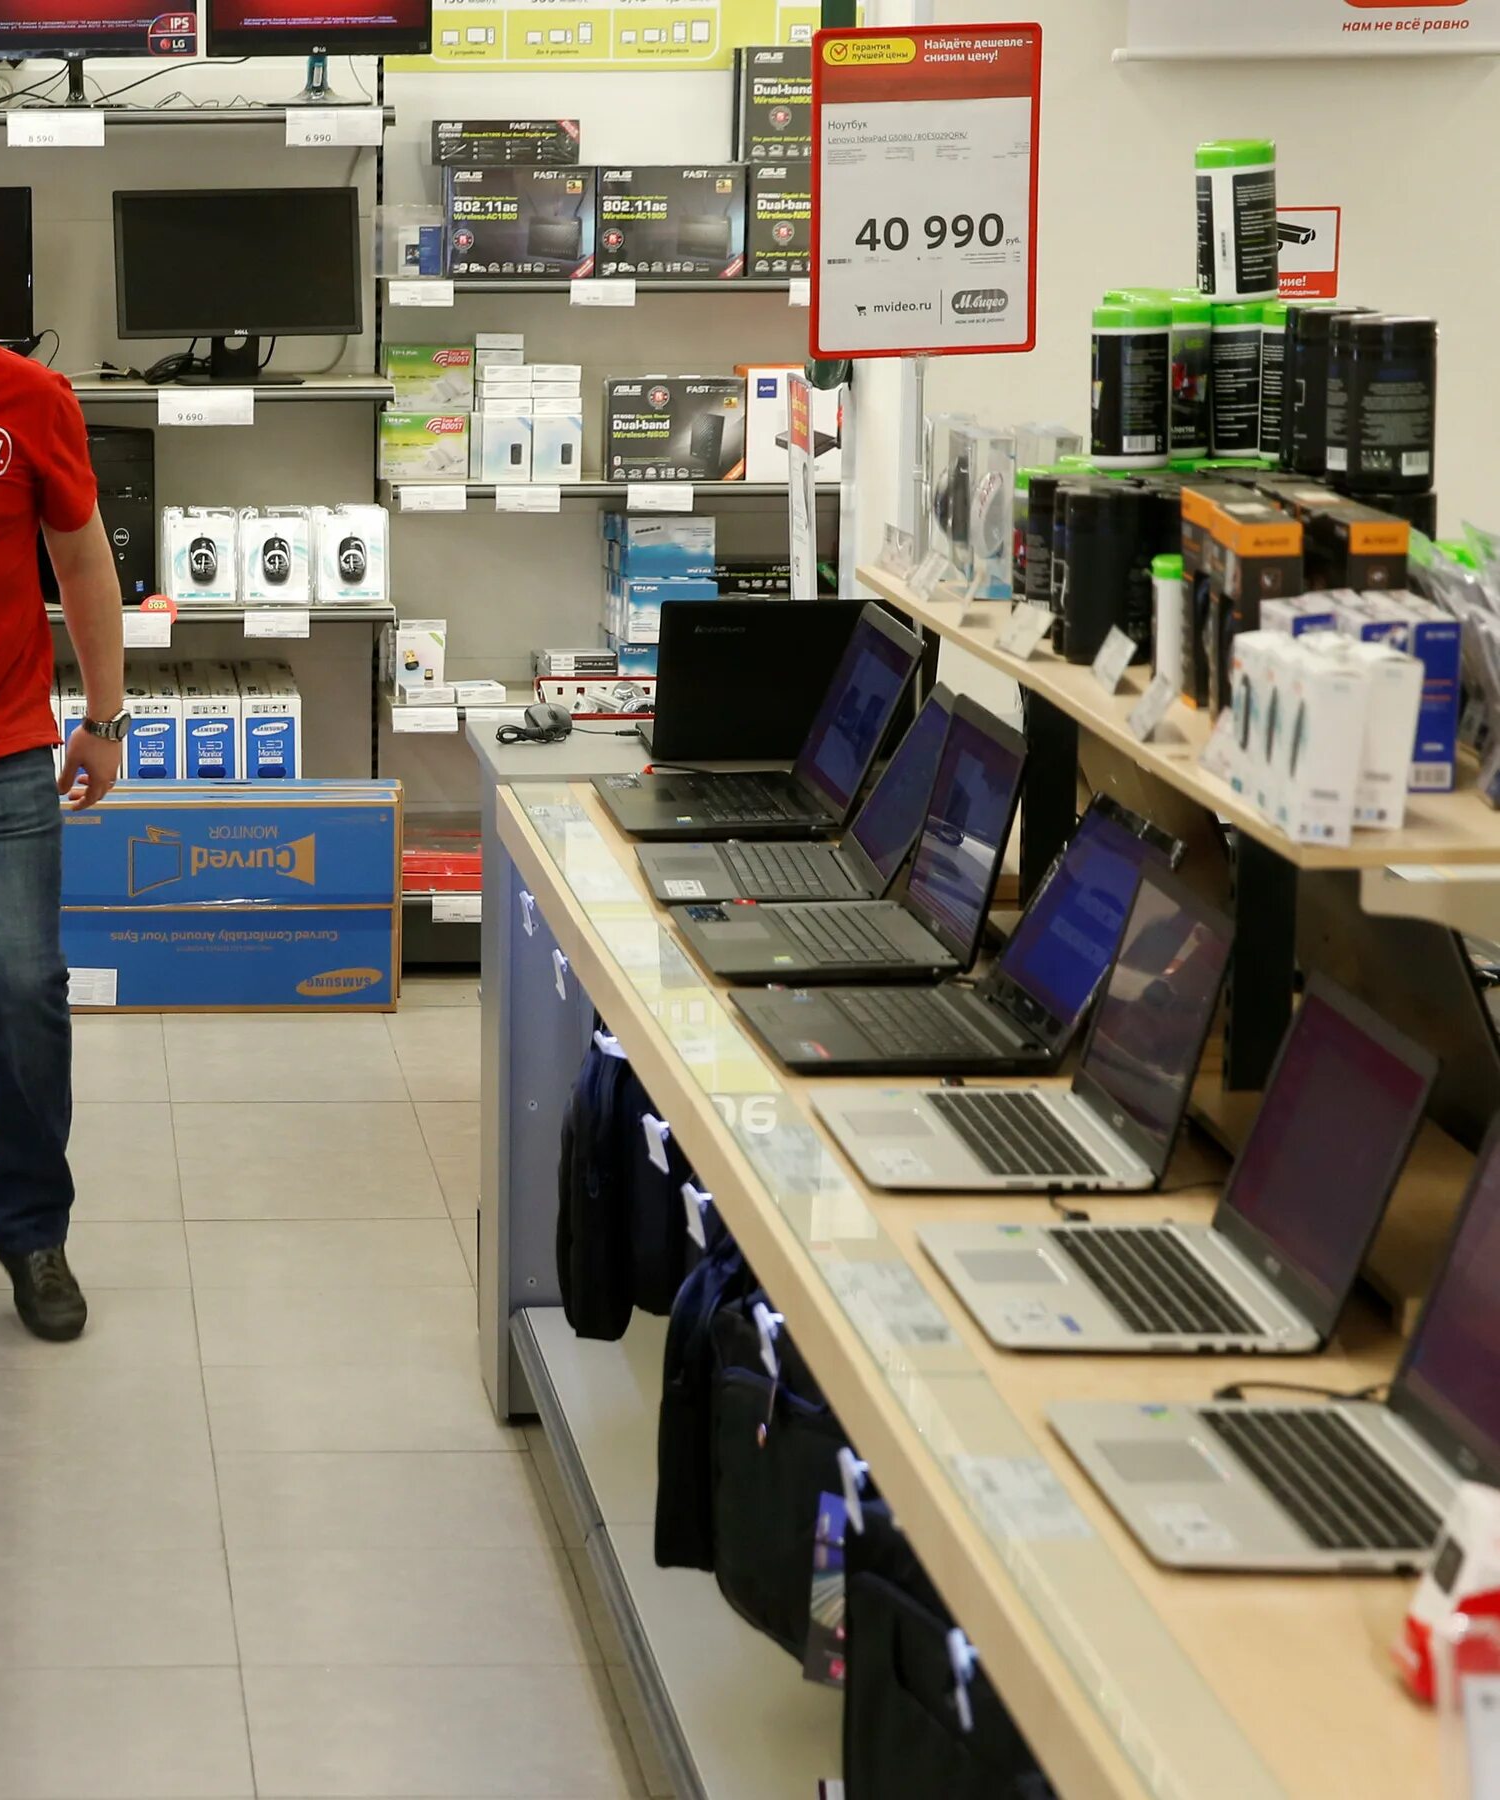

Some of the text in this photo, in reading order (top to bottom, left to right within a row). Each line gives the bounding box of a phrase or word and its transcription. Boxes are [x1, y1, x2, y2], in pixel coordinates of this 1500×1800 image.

[170, 17, 190, 30] IPS
[1342, 17, 1469, 34] нам не всё равно
[173, 39, 185, 48] LG
[852, 43, 891, 52] Гарантия
[924, 38, 1023, 50] Найдёте дешевле
[754, 52, 784, 61] ASUS
[852, 51, 908, 60] лучшей цены
[924, 51, 998, 64] снизим цену!
[509, 122, 531, 130] FAST
[827, 120, 867, 131] Ноутбук
[28, 135, 34, 143] 8
[828, 136, 856, 145] Lenovo
[857, 134, 887, 144] IdeaPad
[453, 171, 483, 180] ASUS
[532, 171, 559, 180] FAST
[603, 170, 633, 179] ASUS
[682, 170, 708, 179] FAST
[757, 167, 788, 177] ASUS
[453, 201, 518, 212] 802.11ac
[602, 201, 668, 212] 802.11ac
[855, 213, 1021, 251] 40 990 руб.
[1278, 275, 1307, 287] ние!
[873, 301, 932, 313] mvideo.ru
[954, 294, 1005, 311] М.видео
[449, 354, 470, 364] BOOST
[613, 384, 643, 394] ASUS
[686, 385, 709, 394] FAST
[177, 413, 183, 421] 9
[441, 421, 463, 431] BOOST
[612, 419, 670, 430] Dual-band
[139, 741, 164, 750] LED
[198, 741, 222, 750] LED
[258, 740, 283, 749] LED
[209, 826, 279, 839] MONITOR
[191, 845, 296, 876] Curved
[110, 929, 338, 943] Curved Comfortably Around Your Eyes
[306, 976, 372, 989] SAMSUNG
